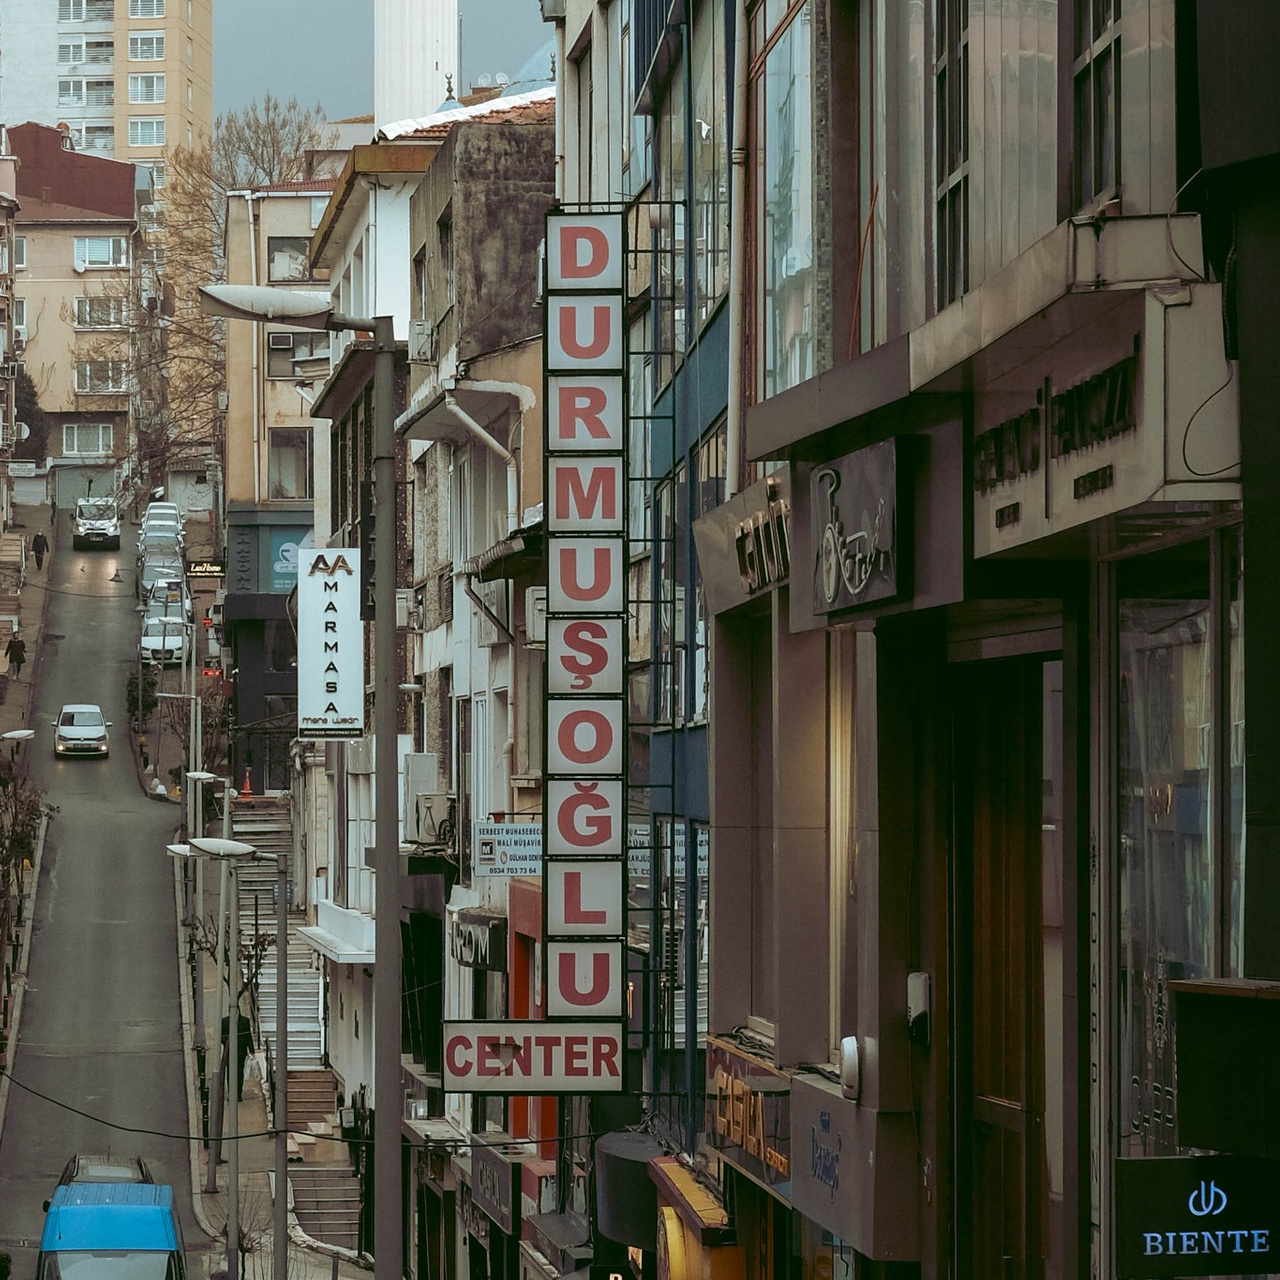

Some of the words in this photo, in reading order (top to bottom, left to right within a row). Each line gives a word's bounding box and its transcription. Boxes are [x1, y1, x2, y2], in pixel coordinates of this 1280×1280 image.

[555, 225, 616, 1007] DURMUŞOĞLU
[324, 581, 339, 713] MARMASA
[479, 828, 504, 836] SERBEST
[446, 1035, 620, 1078] CENTER
[1143, 1229, 1270, 1256] BIENTE
